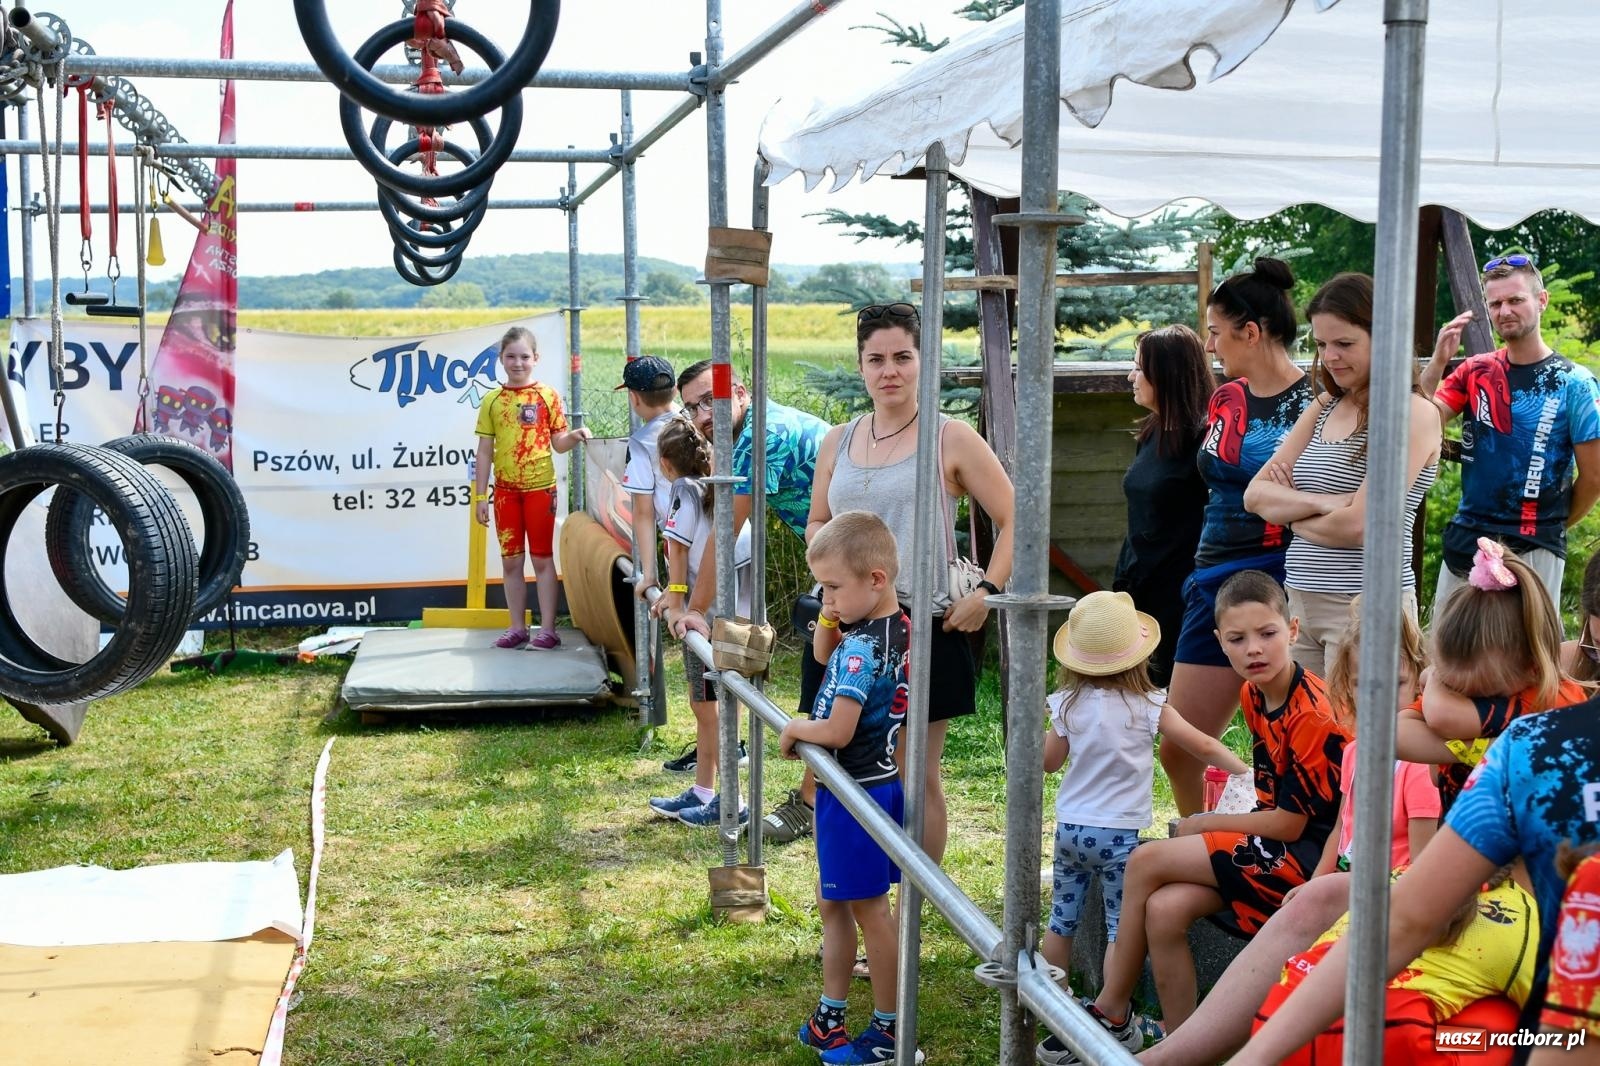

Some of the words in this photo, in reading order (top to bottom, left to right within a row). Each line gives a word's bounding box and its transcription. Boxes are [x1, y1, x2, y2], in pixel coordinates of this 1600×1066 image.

[1532, 396, 1561, 453] RYBNIK
[252, 449, 340, 474] Pszów,
[352, 447, 381, 470] ul.
[333, 489, 373, 511] tel:
[385, 487, 416, 509] 32
[426, 485, 471, 507] 453
